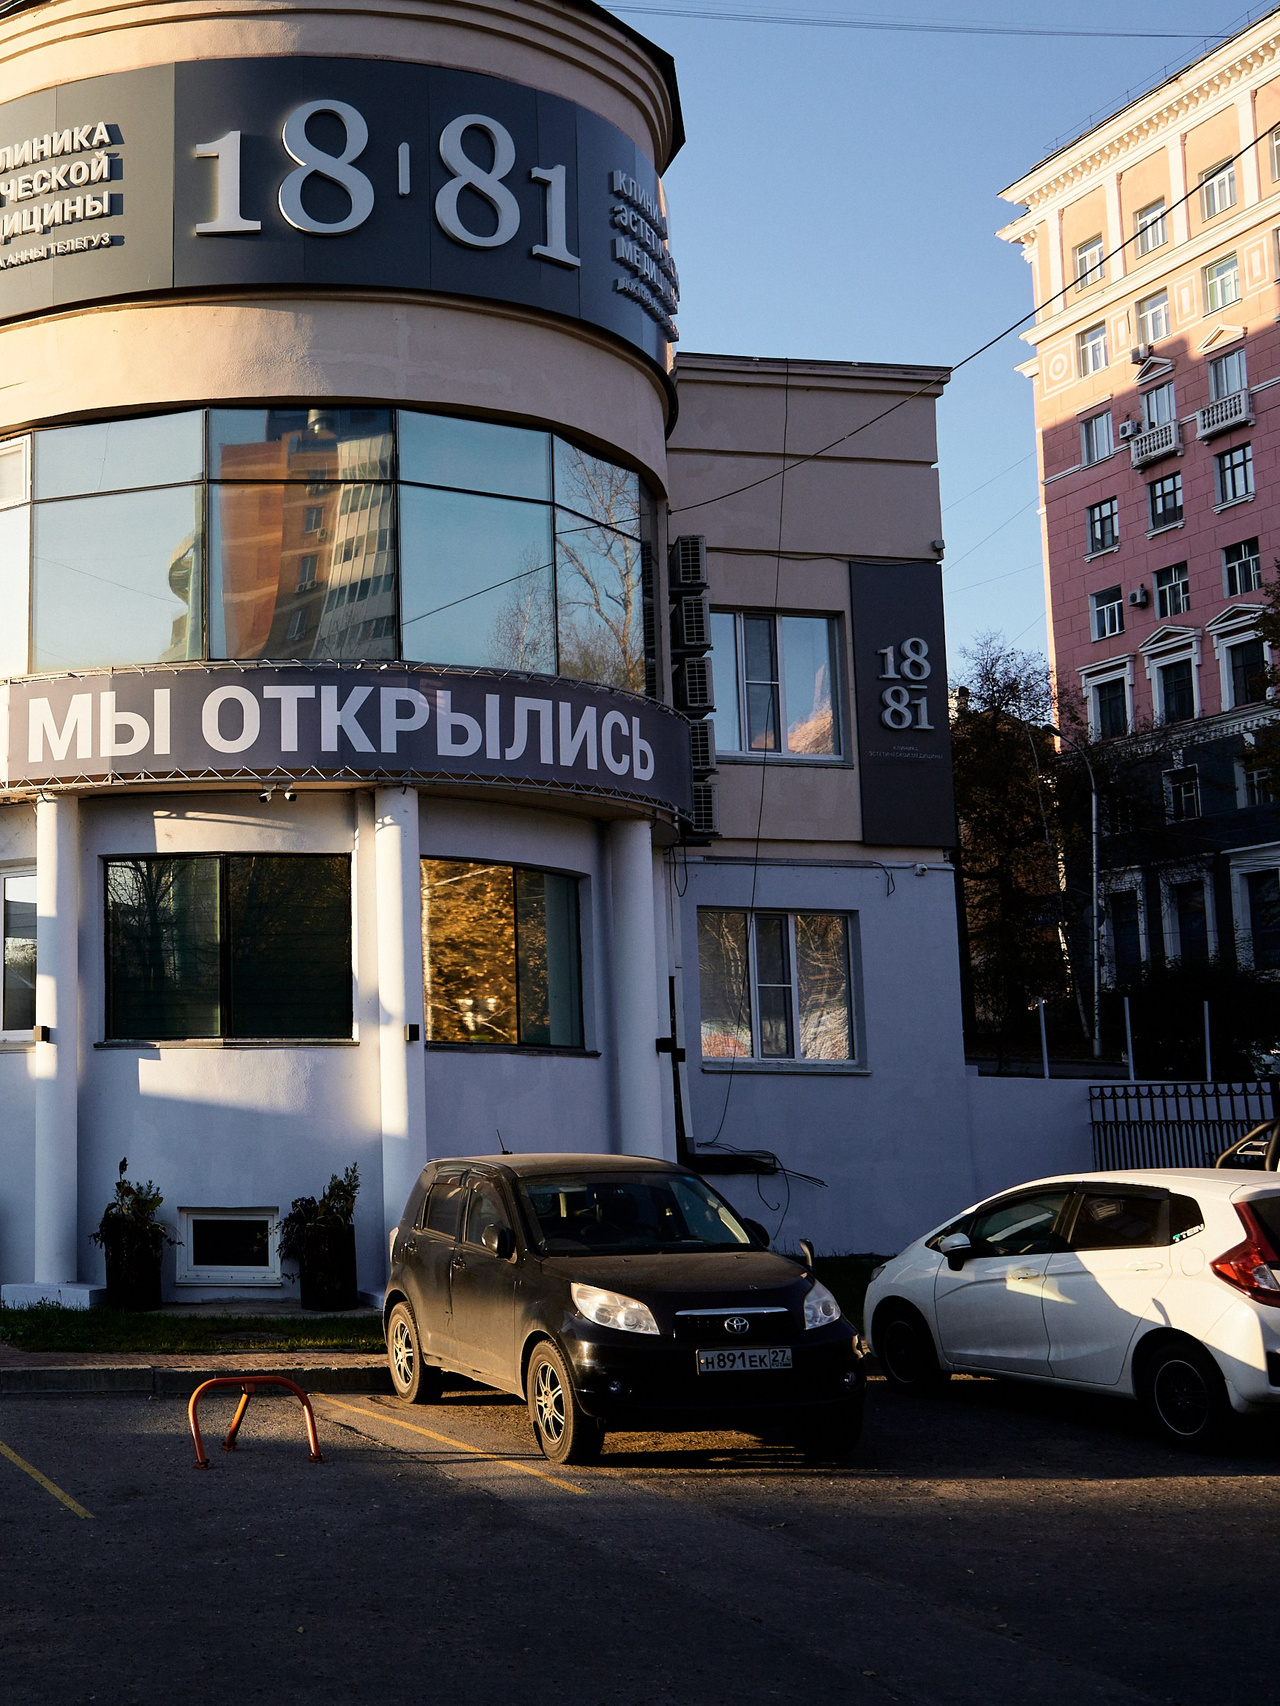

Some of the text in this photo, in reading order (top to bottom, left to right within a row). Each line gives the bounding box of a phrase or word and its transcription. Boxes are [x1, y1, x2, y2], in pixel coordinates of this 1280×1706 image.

[6, 245, 48, 269] АННЫ
[48, 232, 111, 256] ТЕЛЕГУЗ
[877, 636, 932, 681] 18
[881, 685, 935, 730] 81
[27, 684, 656, 783] МЫ ОТКРЫЛИСЬ
